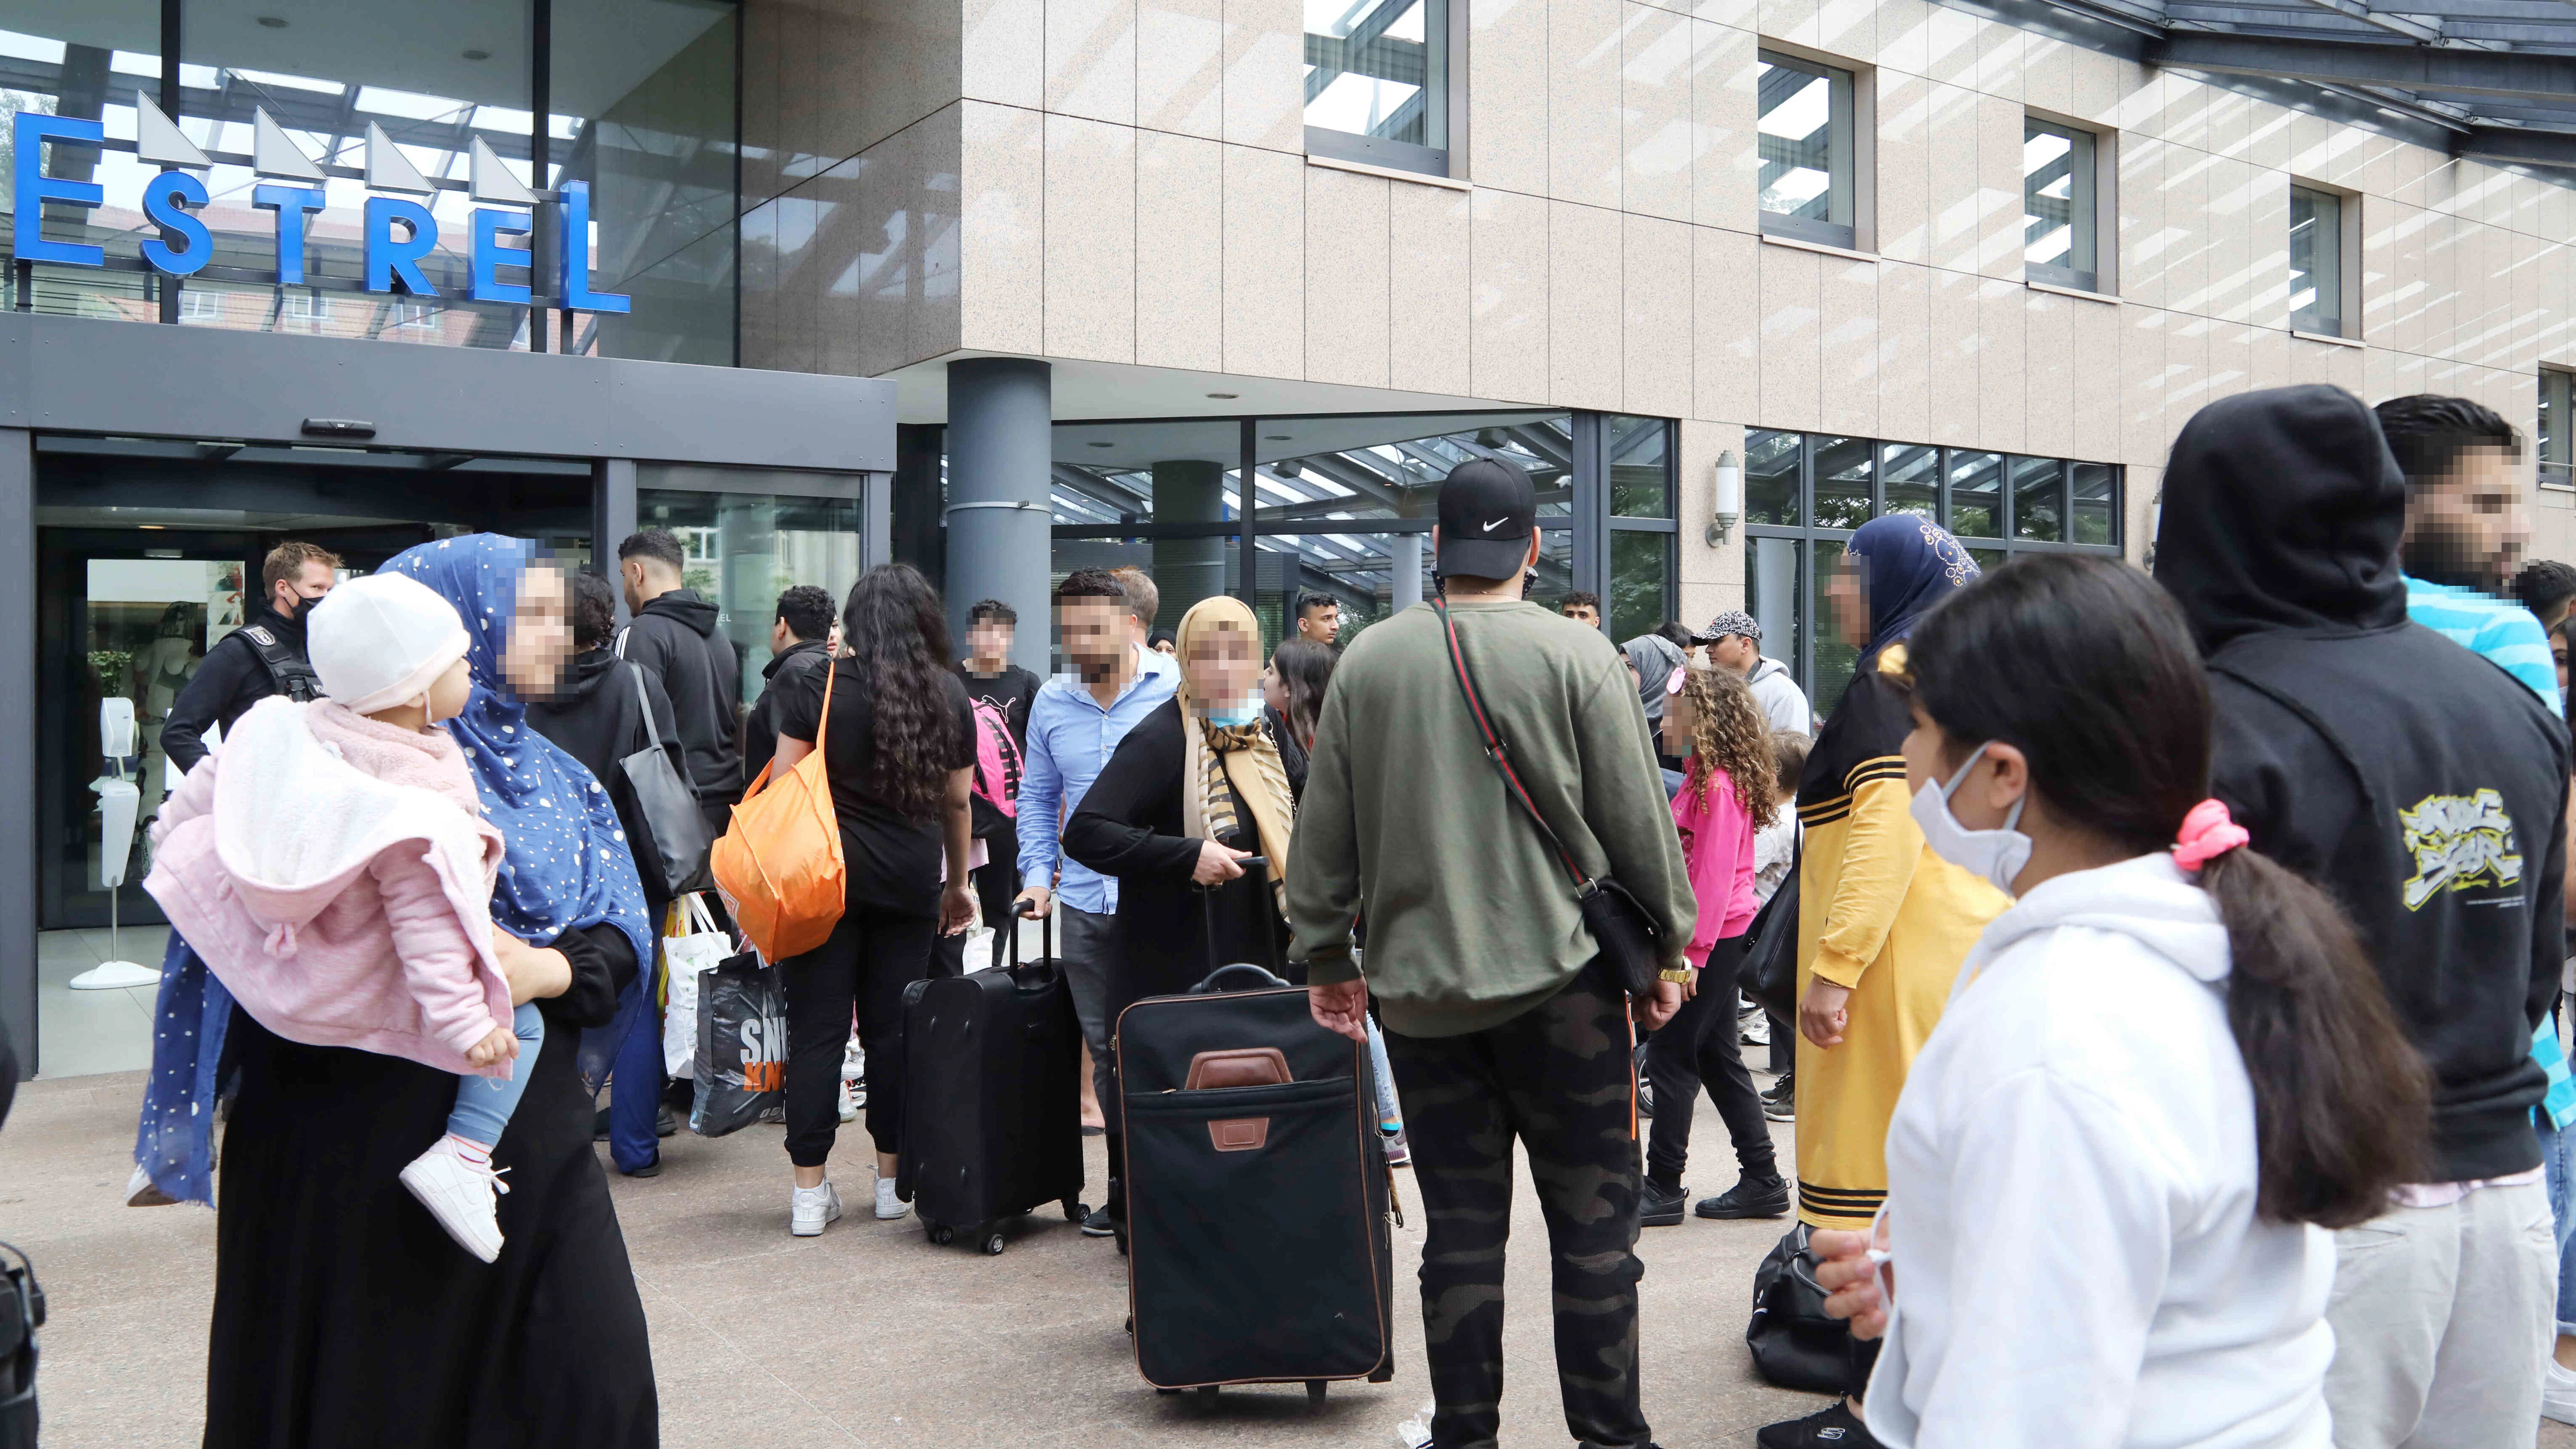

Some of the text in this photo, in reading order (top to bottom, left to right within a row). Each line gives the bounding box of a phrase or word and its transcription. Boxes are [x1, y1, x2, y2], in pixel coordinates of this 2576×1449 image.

[13, 111, 630, 313] ESTREL
[313, 684, 323, 693] PO
[740, 1017, 789, 1066] SNI
